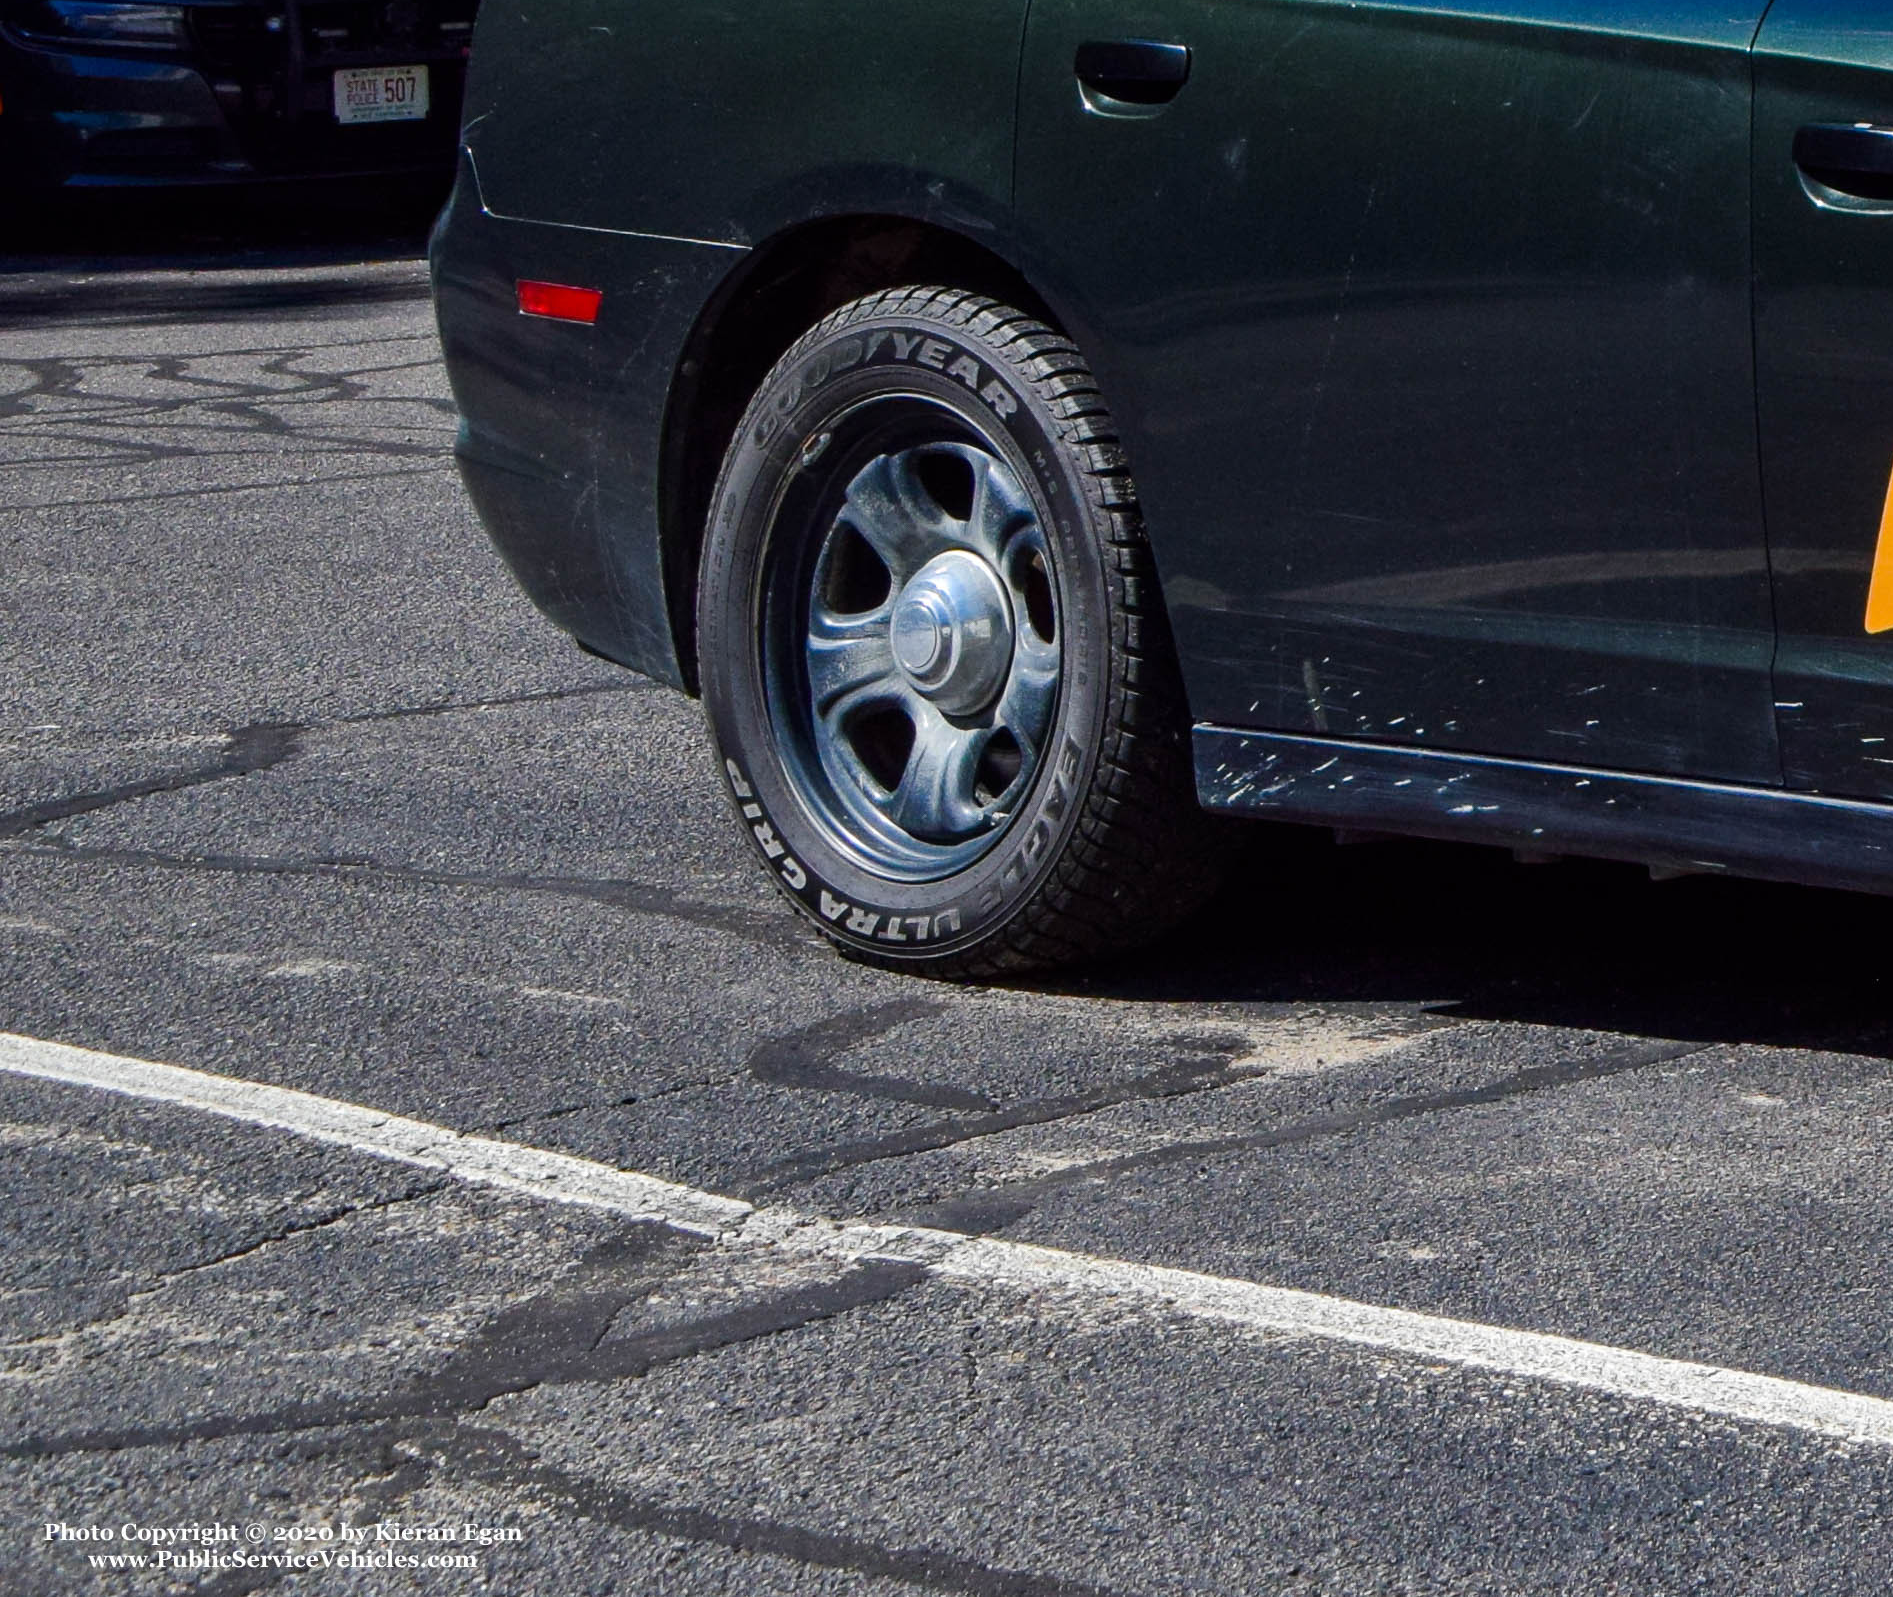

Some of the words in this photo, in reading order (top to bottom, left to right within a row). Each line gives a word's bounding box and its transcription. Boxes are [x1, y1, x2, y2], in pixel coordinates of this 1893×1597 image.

[346, 79, 377, 93] STATE
[385, 77, 416, 103] 507
[754, 330, 1018, 450] GOODYEAR
[726, 758, 807, 890] GRIP
[820, 890, 961, 941] ULTRA
